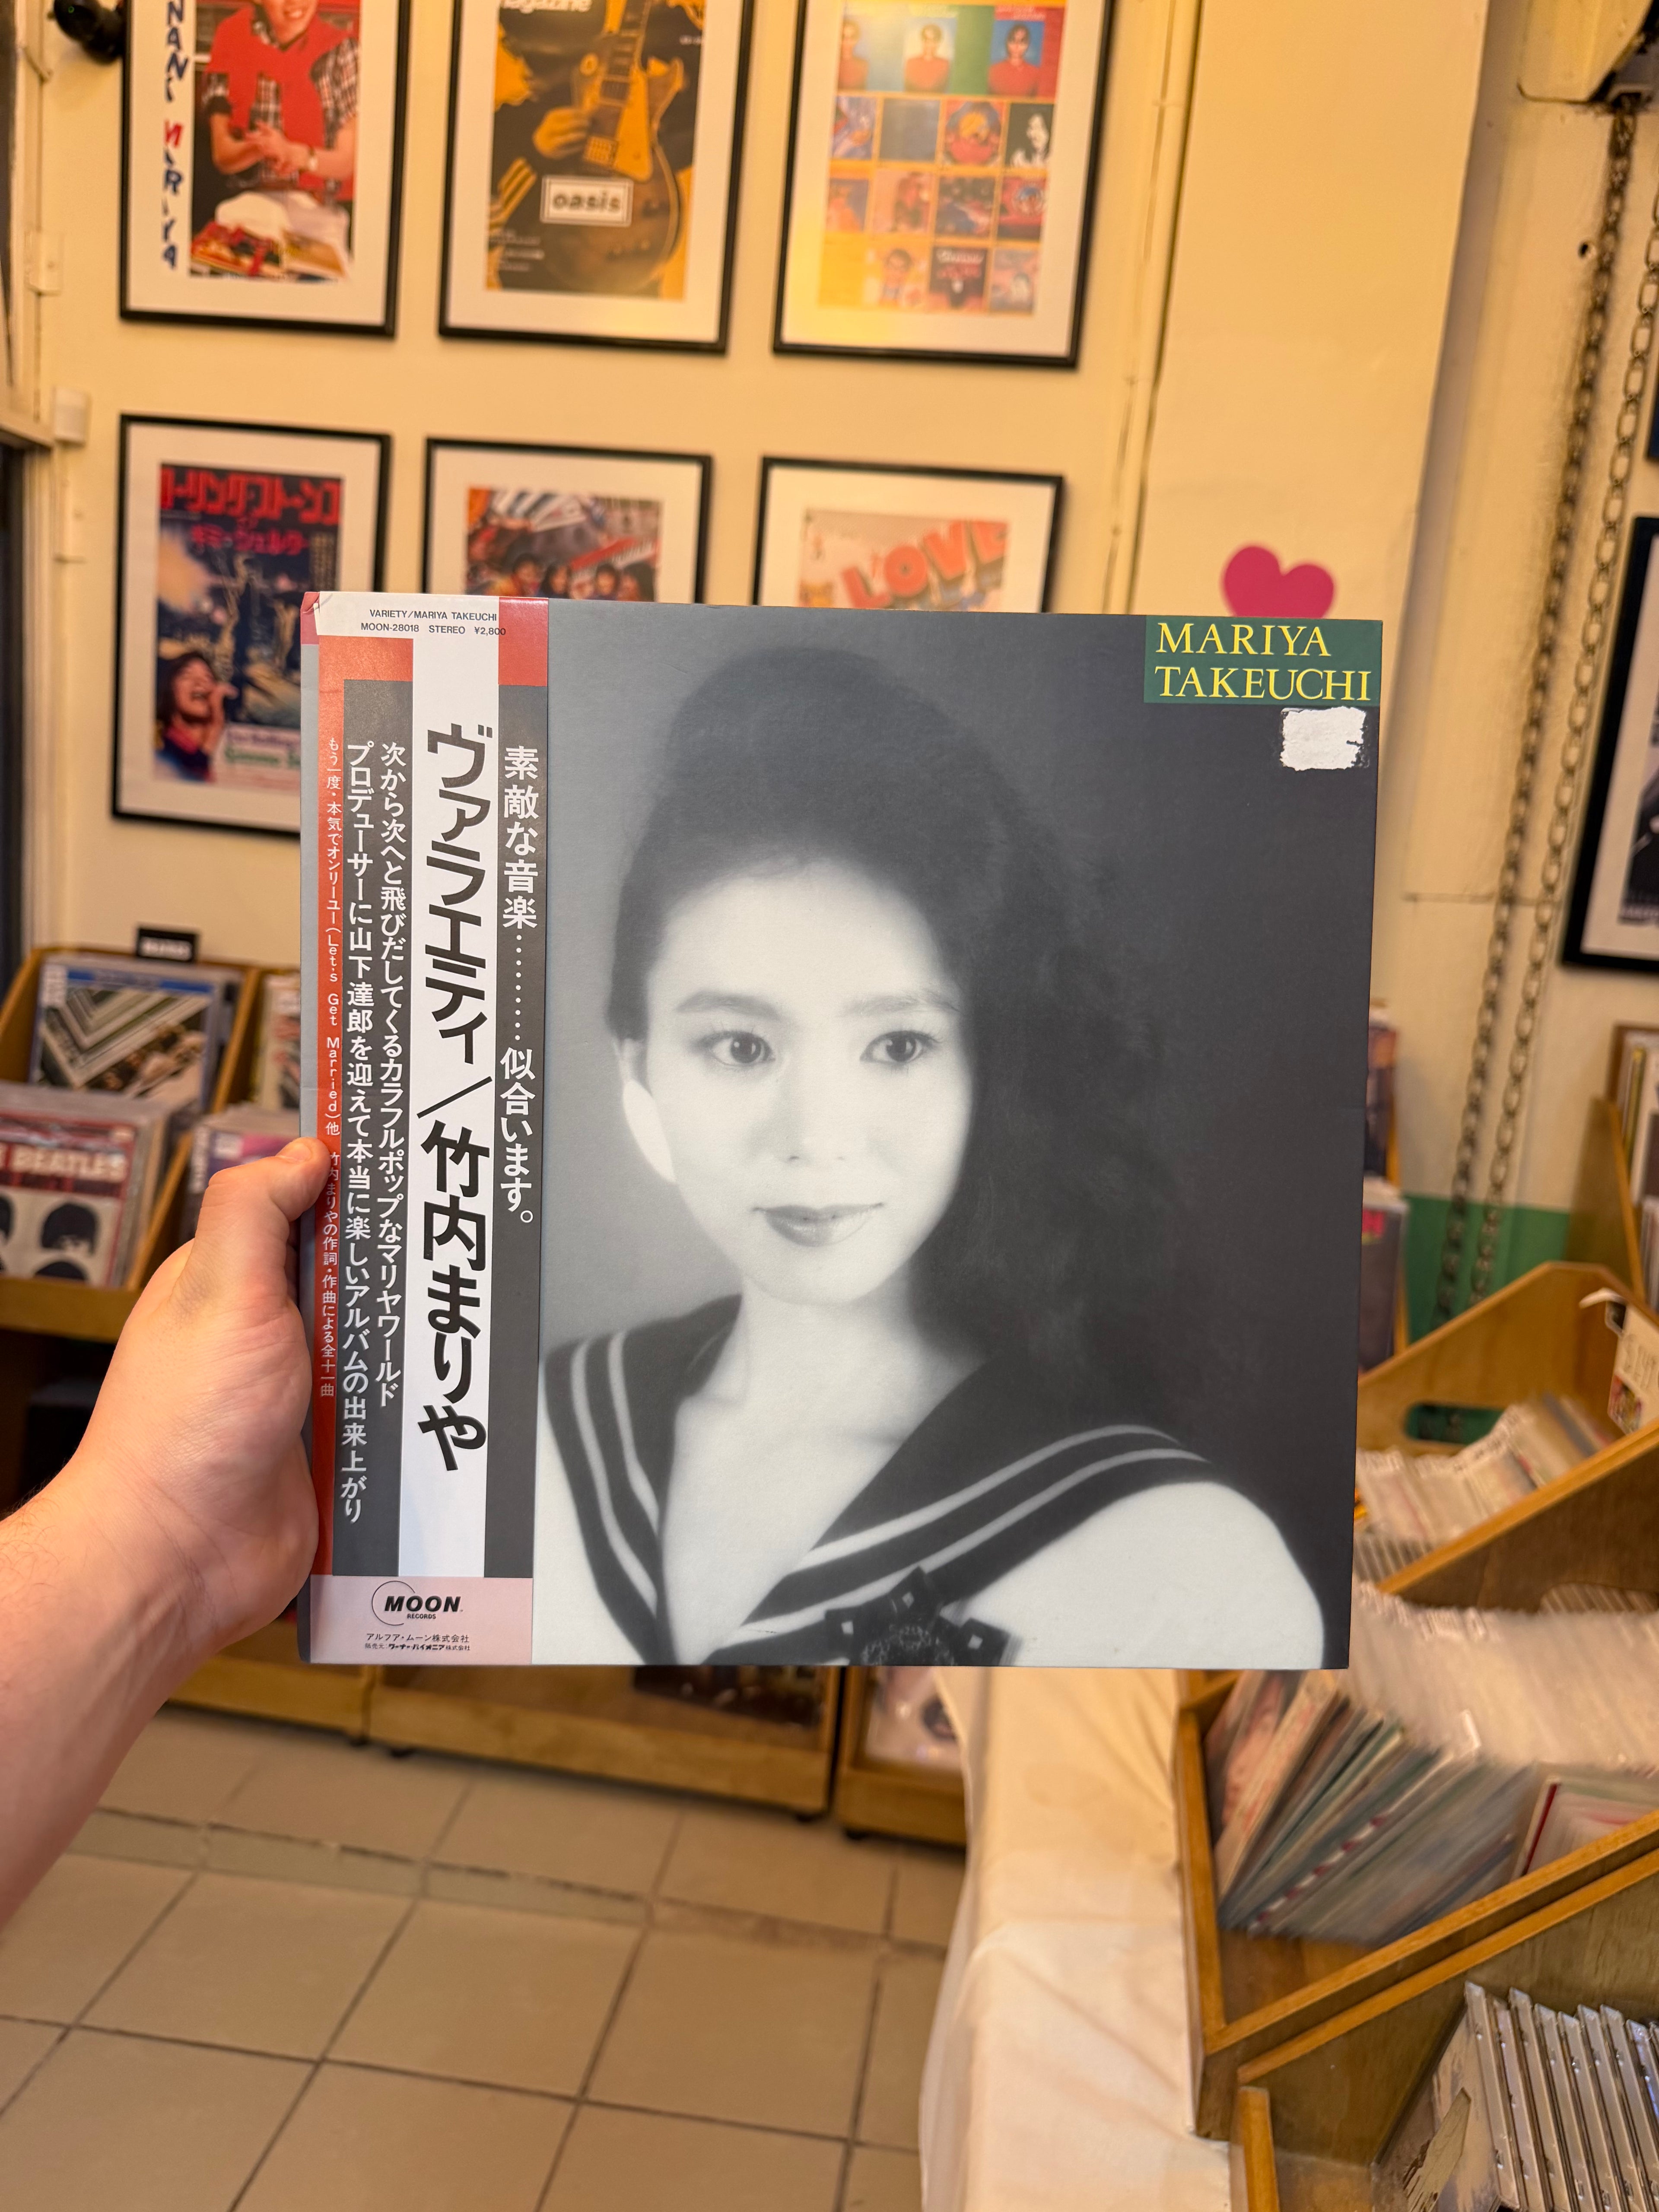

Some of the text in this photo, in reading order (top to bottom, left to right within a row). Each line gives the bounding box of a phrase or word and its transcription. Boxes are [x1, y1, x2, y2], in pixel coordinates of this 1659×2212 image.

[553, 191, 621, 213] oasis
[369, 609, 497, 622] VARIETY/MARIYA TAKEUCHI
[361, 623, 506, 636] MOON-28018 STEREO ¥2,800
[1155, 623, 1331, 657] MARIYA
[1154, 666, 1372, 701] TAKEUCHI
[327, 993, 340, 1026] Get
[13, 1145, 127, 1183] BEATLES
[384, 1595, 461, 1612] MOON
